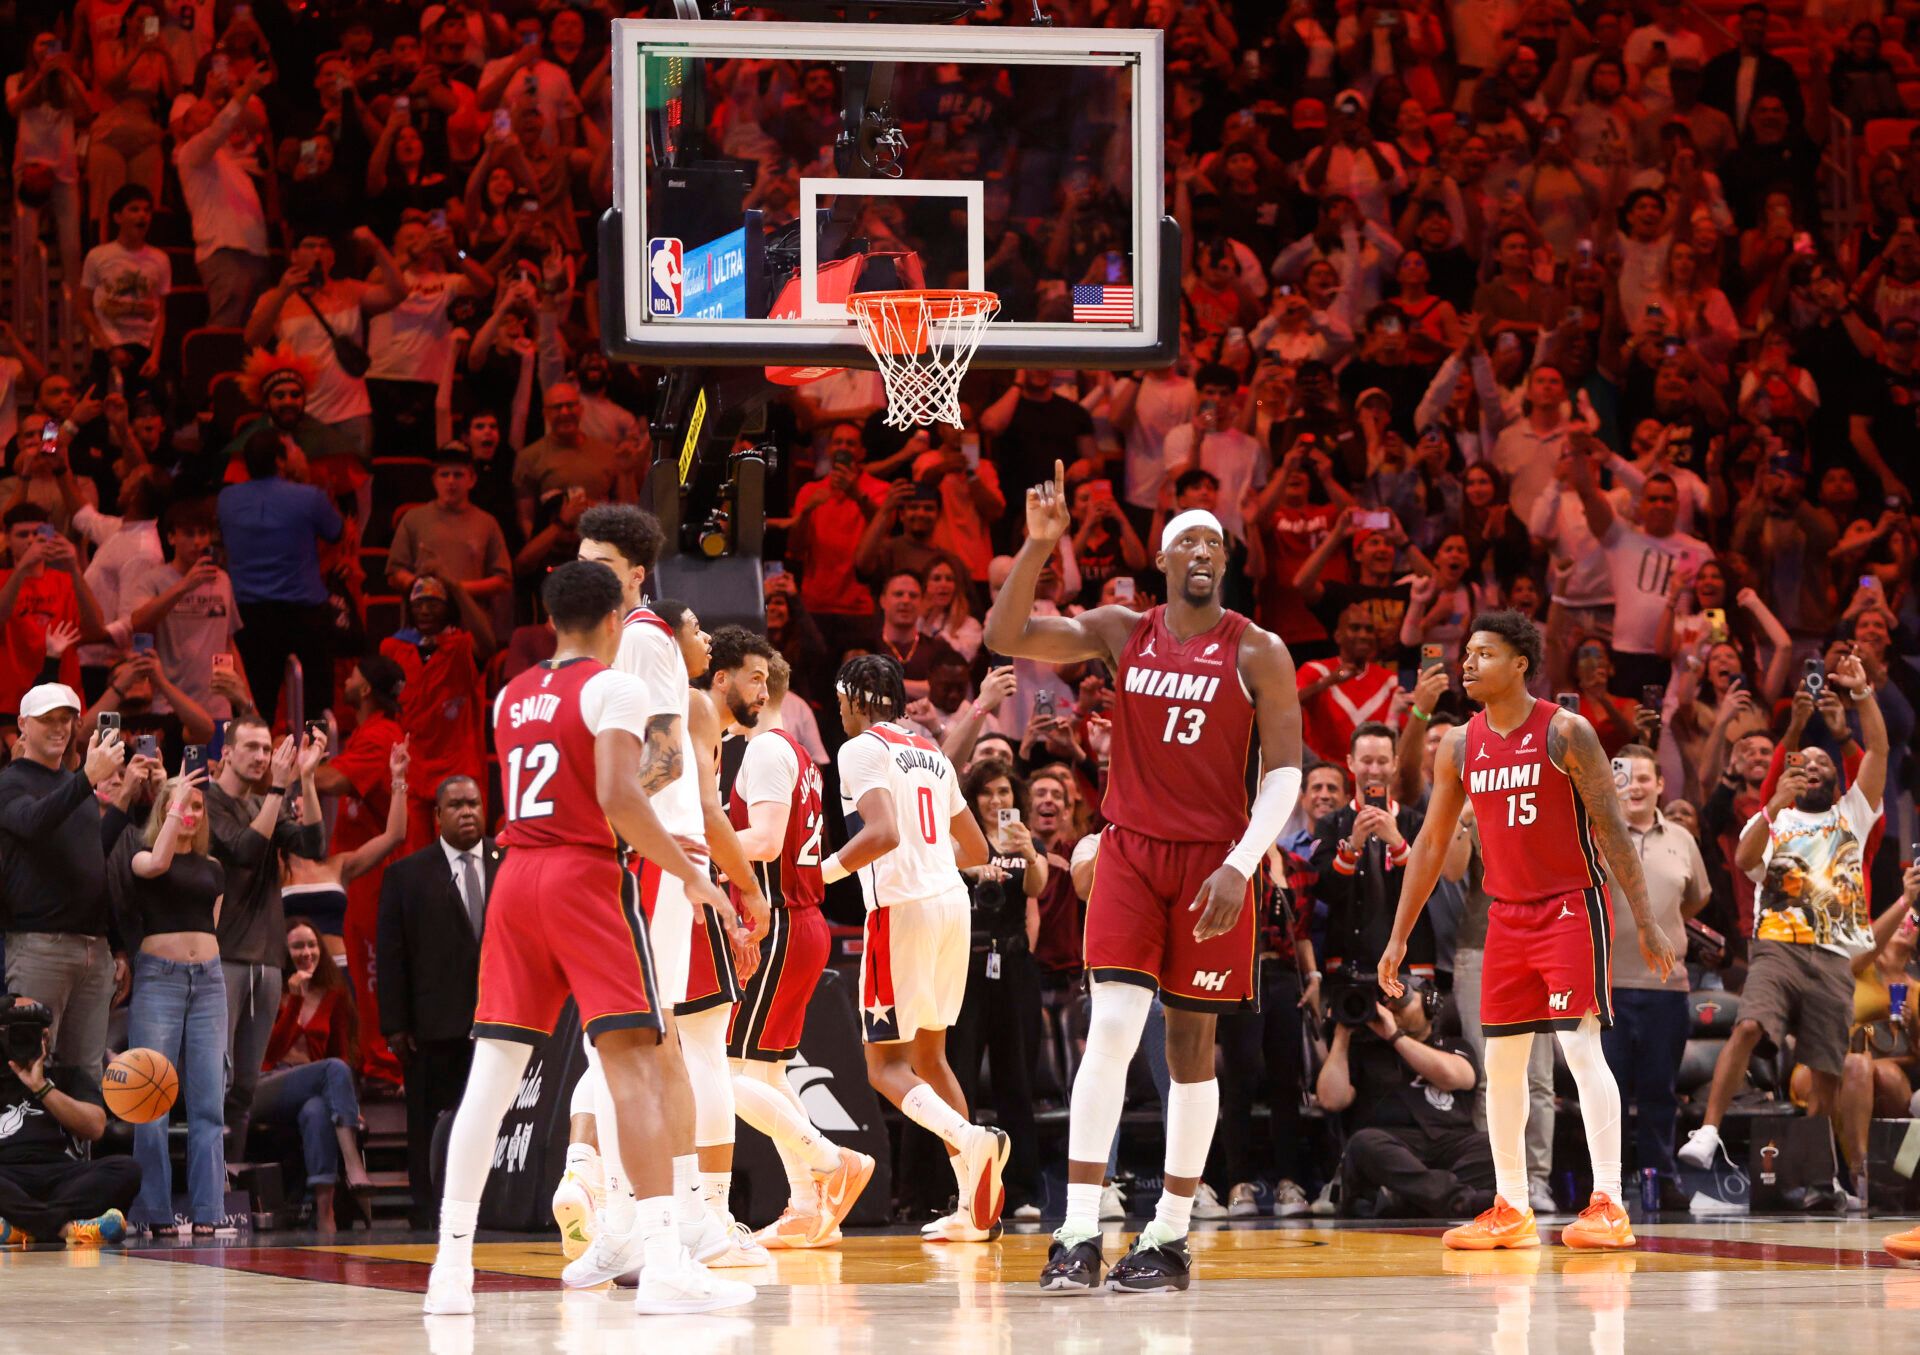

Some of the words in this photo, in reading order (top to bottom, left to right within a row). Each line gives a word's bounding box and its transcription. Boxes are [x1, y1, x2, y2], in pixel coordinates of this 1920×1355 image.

[713, 247, 743, 286] ULTRA
[654, 298, 671, 311] NBA
[1125, 666, 1220, 703] MIAMI
[509, 693, 561, 729] SMITH
[1163, 705, 1206, 745] 13
[508, 742, 560, 822] 12
[895, 750, 946, 780] COULIBALY
[1470, 763, 1541, 794] MIAMI
[917, 786, 937, 845] 0
[1506, 792, 1538, 828] 15
[990, 855, 1028, 869] HEAT
